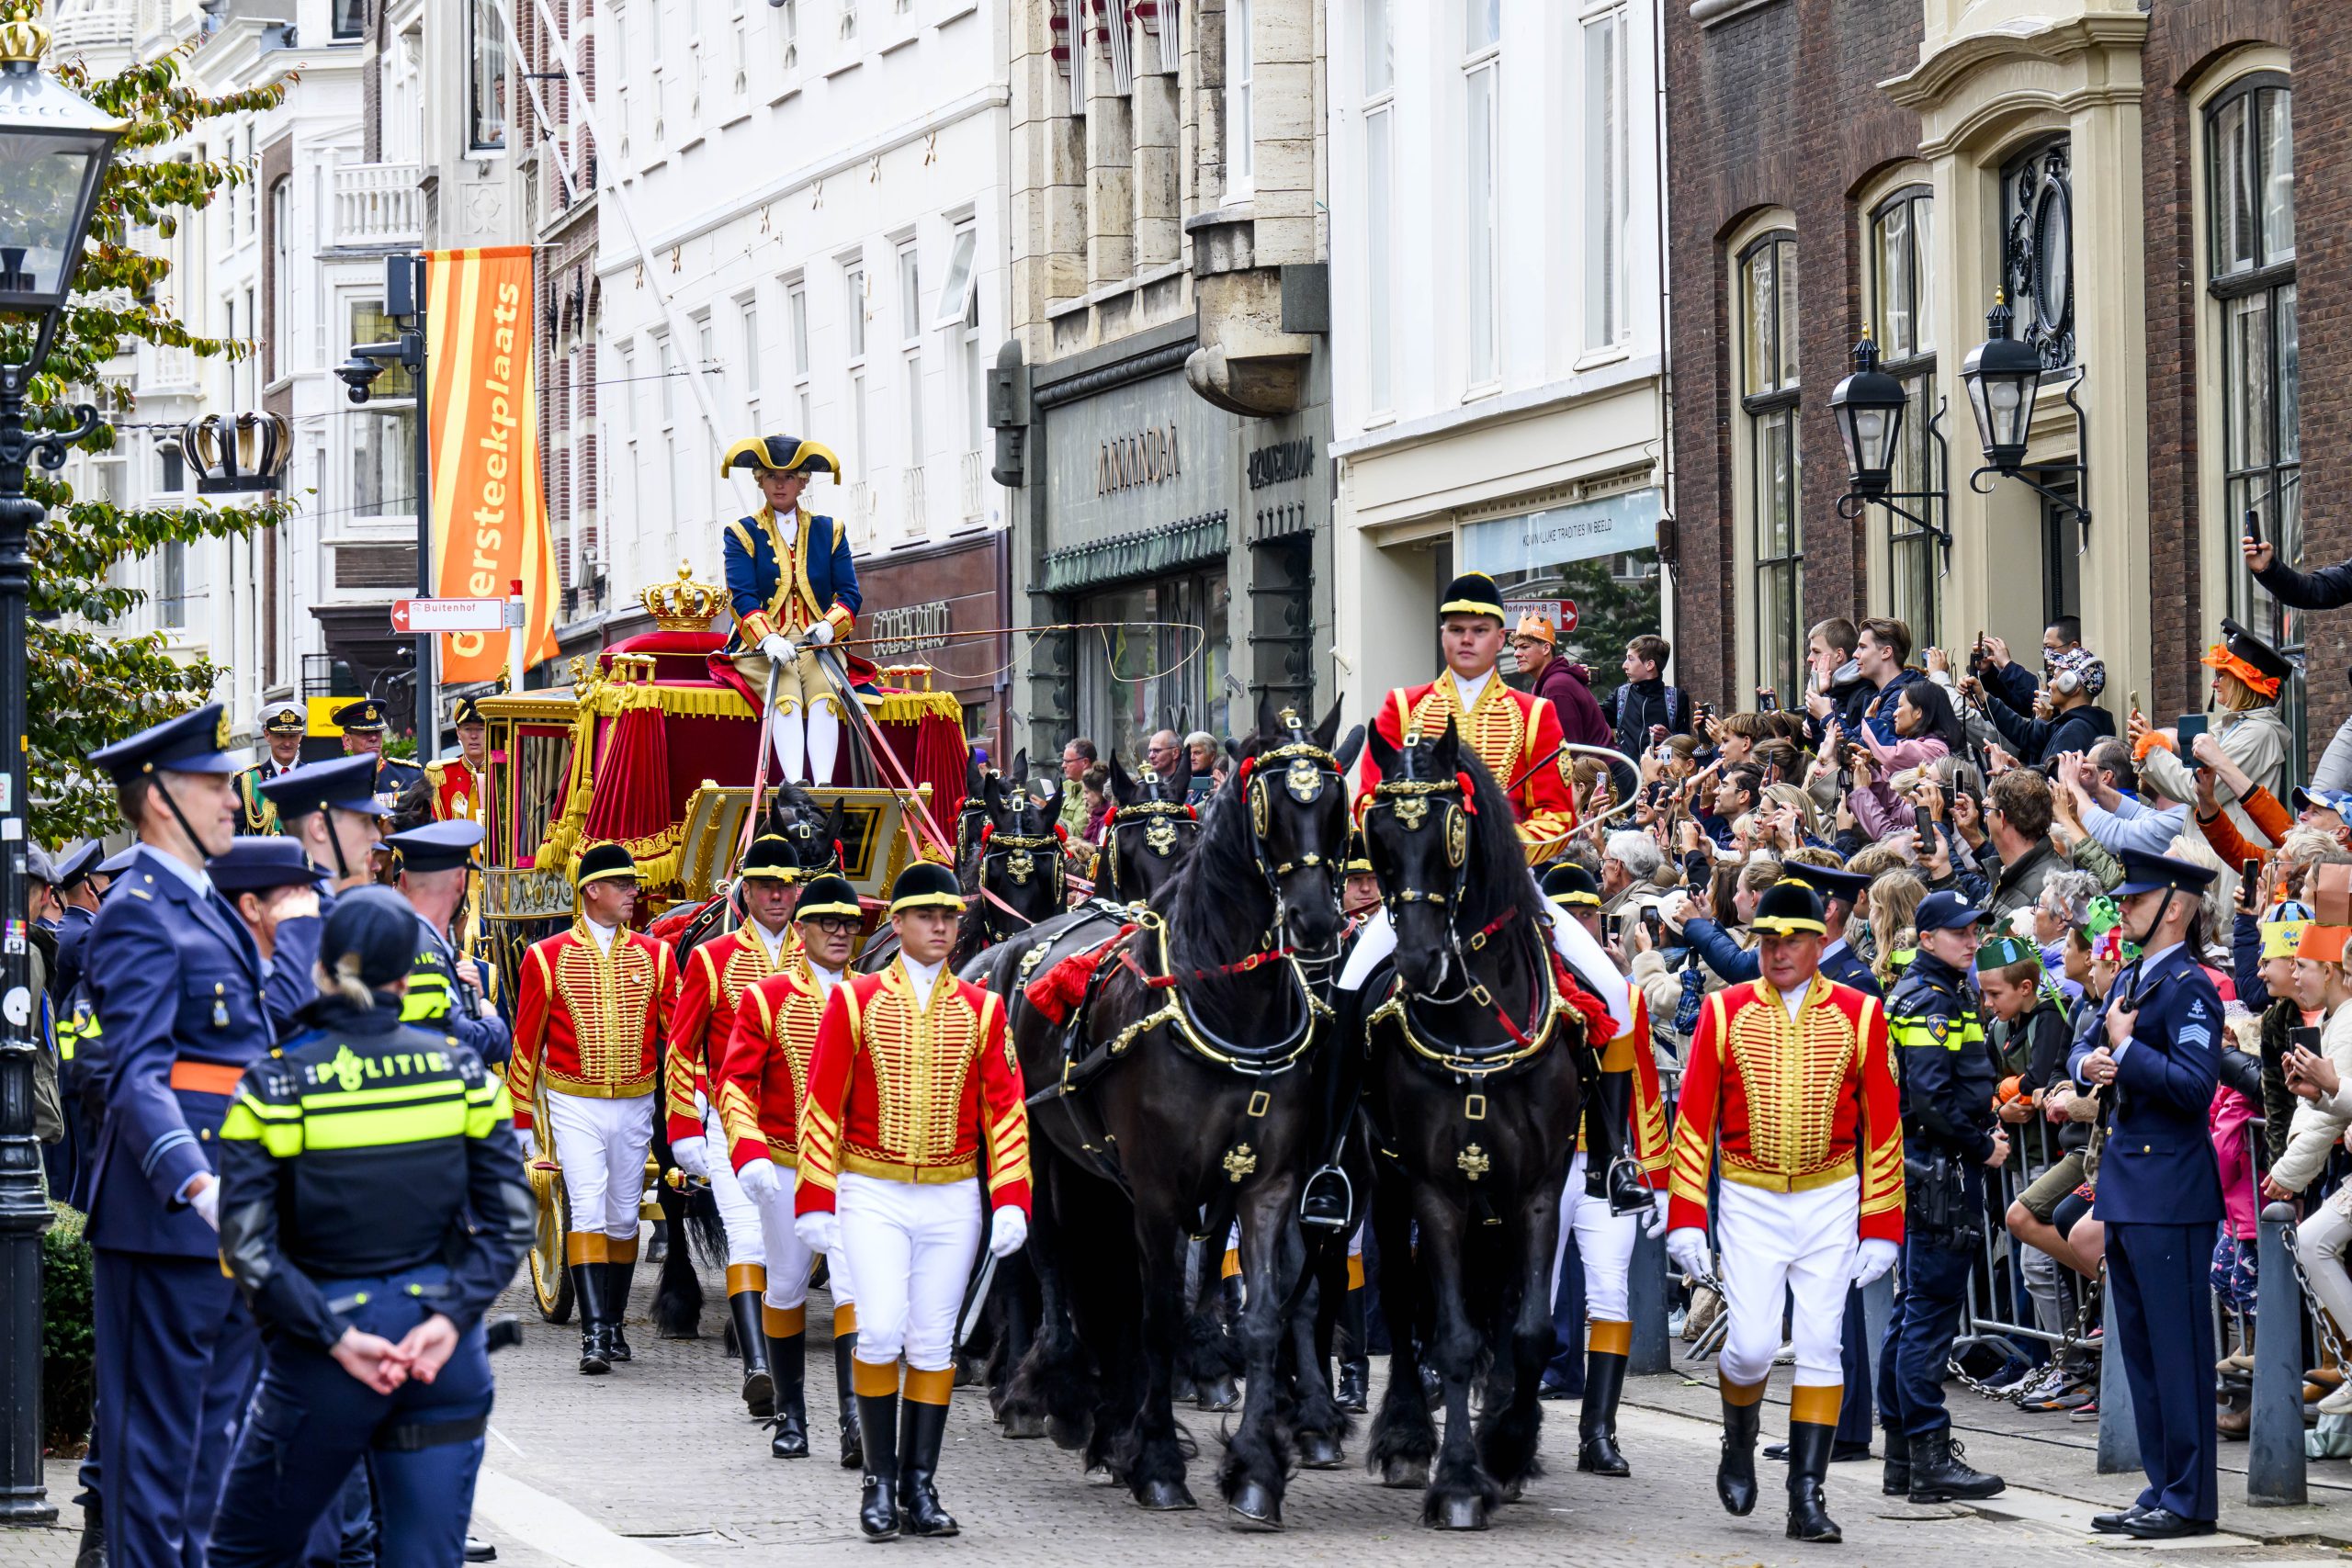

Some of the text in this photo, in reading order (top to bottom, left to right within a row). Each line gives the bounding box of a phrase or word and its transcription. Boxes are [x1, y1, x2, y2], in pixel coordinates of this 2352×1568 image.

[452, 281, 520, 658] Oersteekplaats
[1096, 420, 1179, 498] ANANDA
[1557, 524, 1586, 540] TRADITIES
[1586, 523, 1593, 535] IN
[1594, 518, 1612, 534] BEELD
[424, 603, 476, 613] Buitenhof
[871, 601, 947, 657] GOLDEN RATIO
